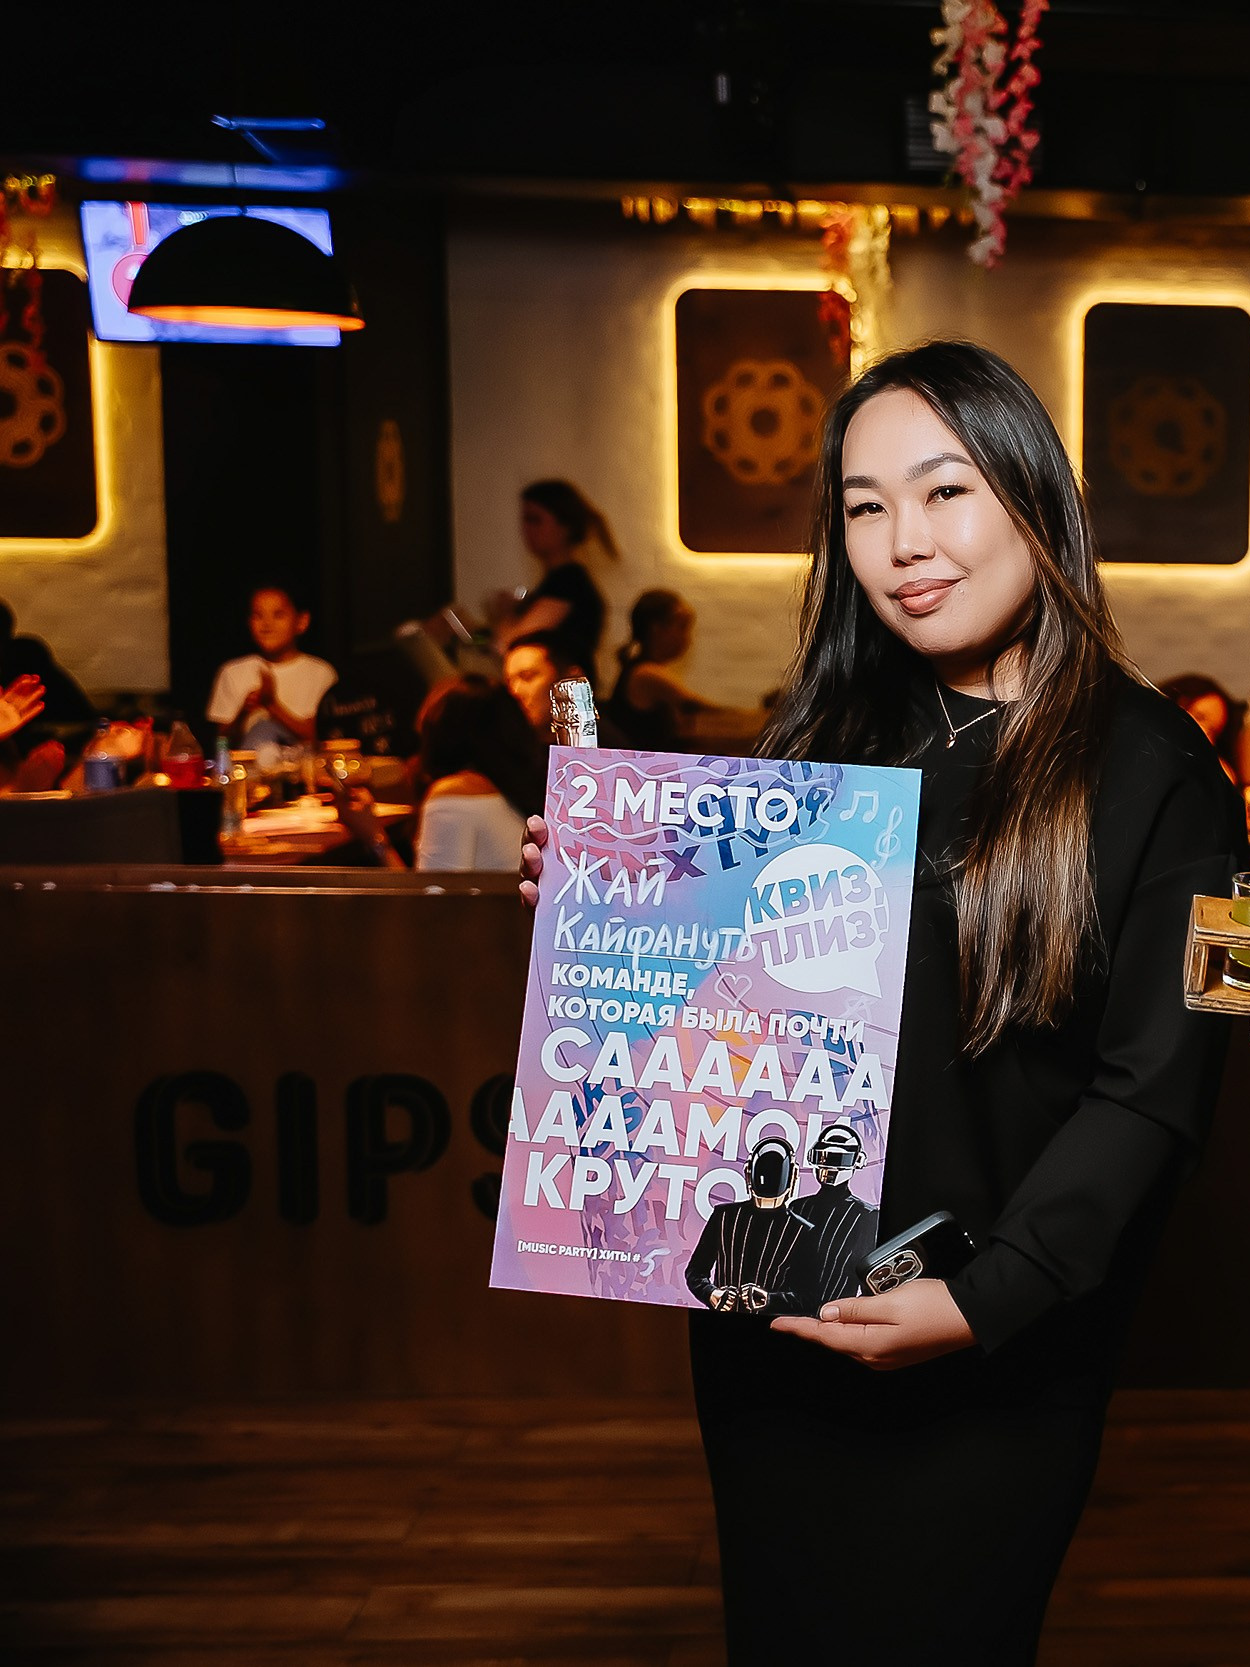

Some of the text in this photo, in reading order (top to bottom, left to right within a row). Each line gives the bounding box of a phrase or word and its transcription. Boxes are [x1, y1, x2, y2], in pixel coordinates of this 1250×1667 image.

[567, 775, 798, 832] 2 МЕСТО
[750, 906, 888, 968] ПЛИЗ!
[551, 963, 696, 1000] КОМАНДЕ,
[547, 994, 865, 1043] КОТОРАЯ БЫЛА ПОЧТИ
[523, 1150, 752, 1223] КРУТО
[517, 1240, 557, 1255] [MUSIC
[558, 1245, 598, 1260] PARTY]
[598, 1249, 631, 1263] ХИТЫ
